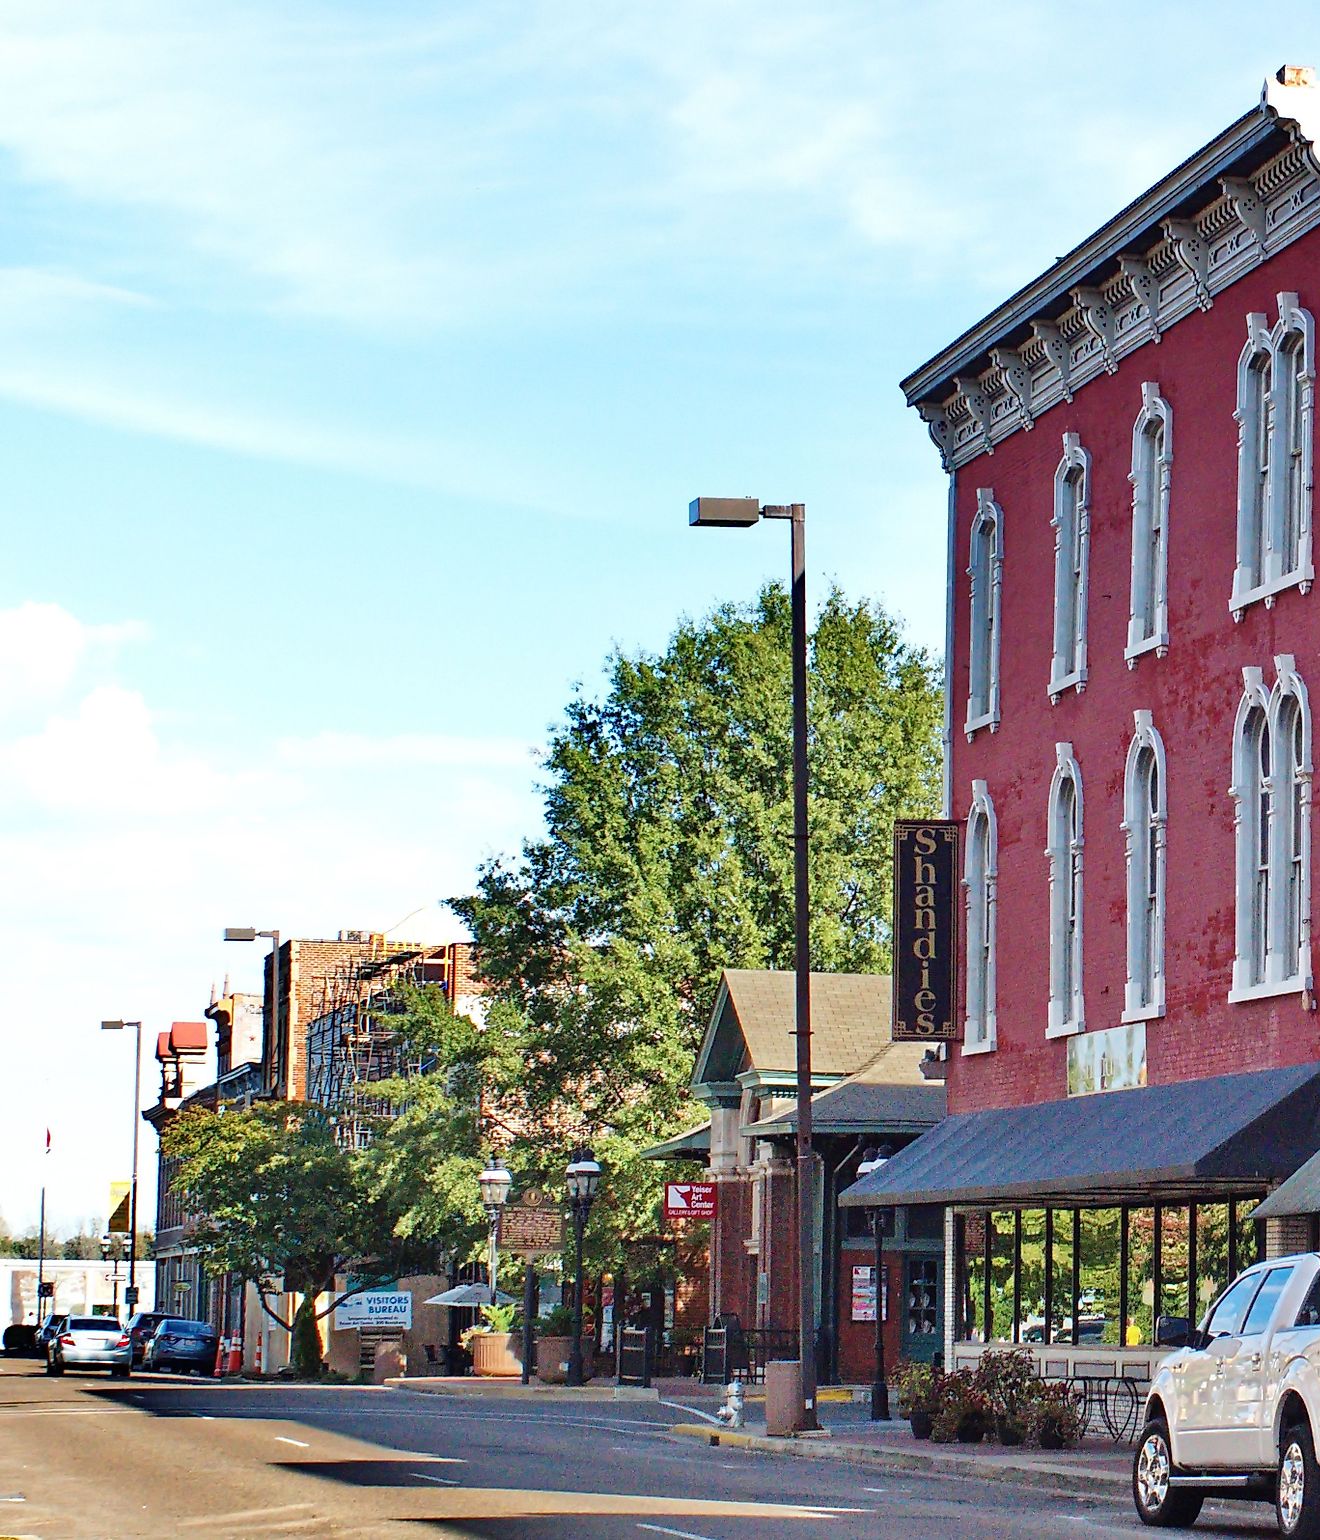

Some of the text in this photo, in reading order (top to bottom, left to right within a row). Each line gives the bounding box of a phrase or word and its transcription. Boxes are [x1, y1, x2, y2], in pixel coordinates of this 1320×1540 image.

[913, 827, 937, 1035] Shandies
[691, 1185, 712, 1193] Yeiser
[691, 1193, 702, 1201] Art
[691, 1200, 714, 1209] Center
[366, 1296, 409, 1305] VISITORS
[369, 1305, 407, 1314] BUREAU
